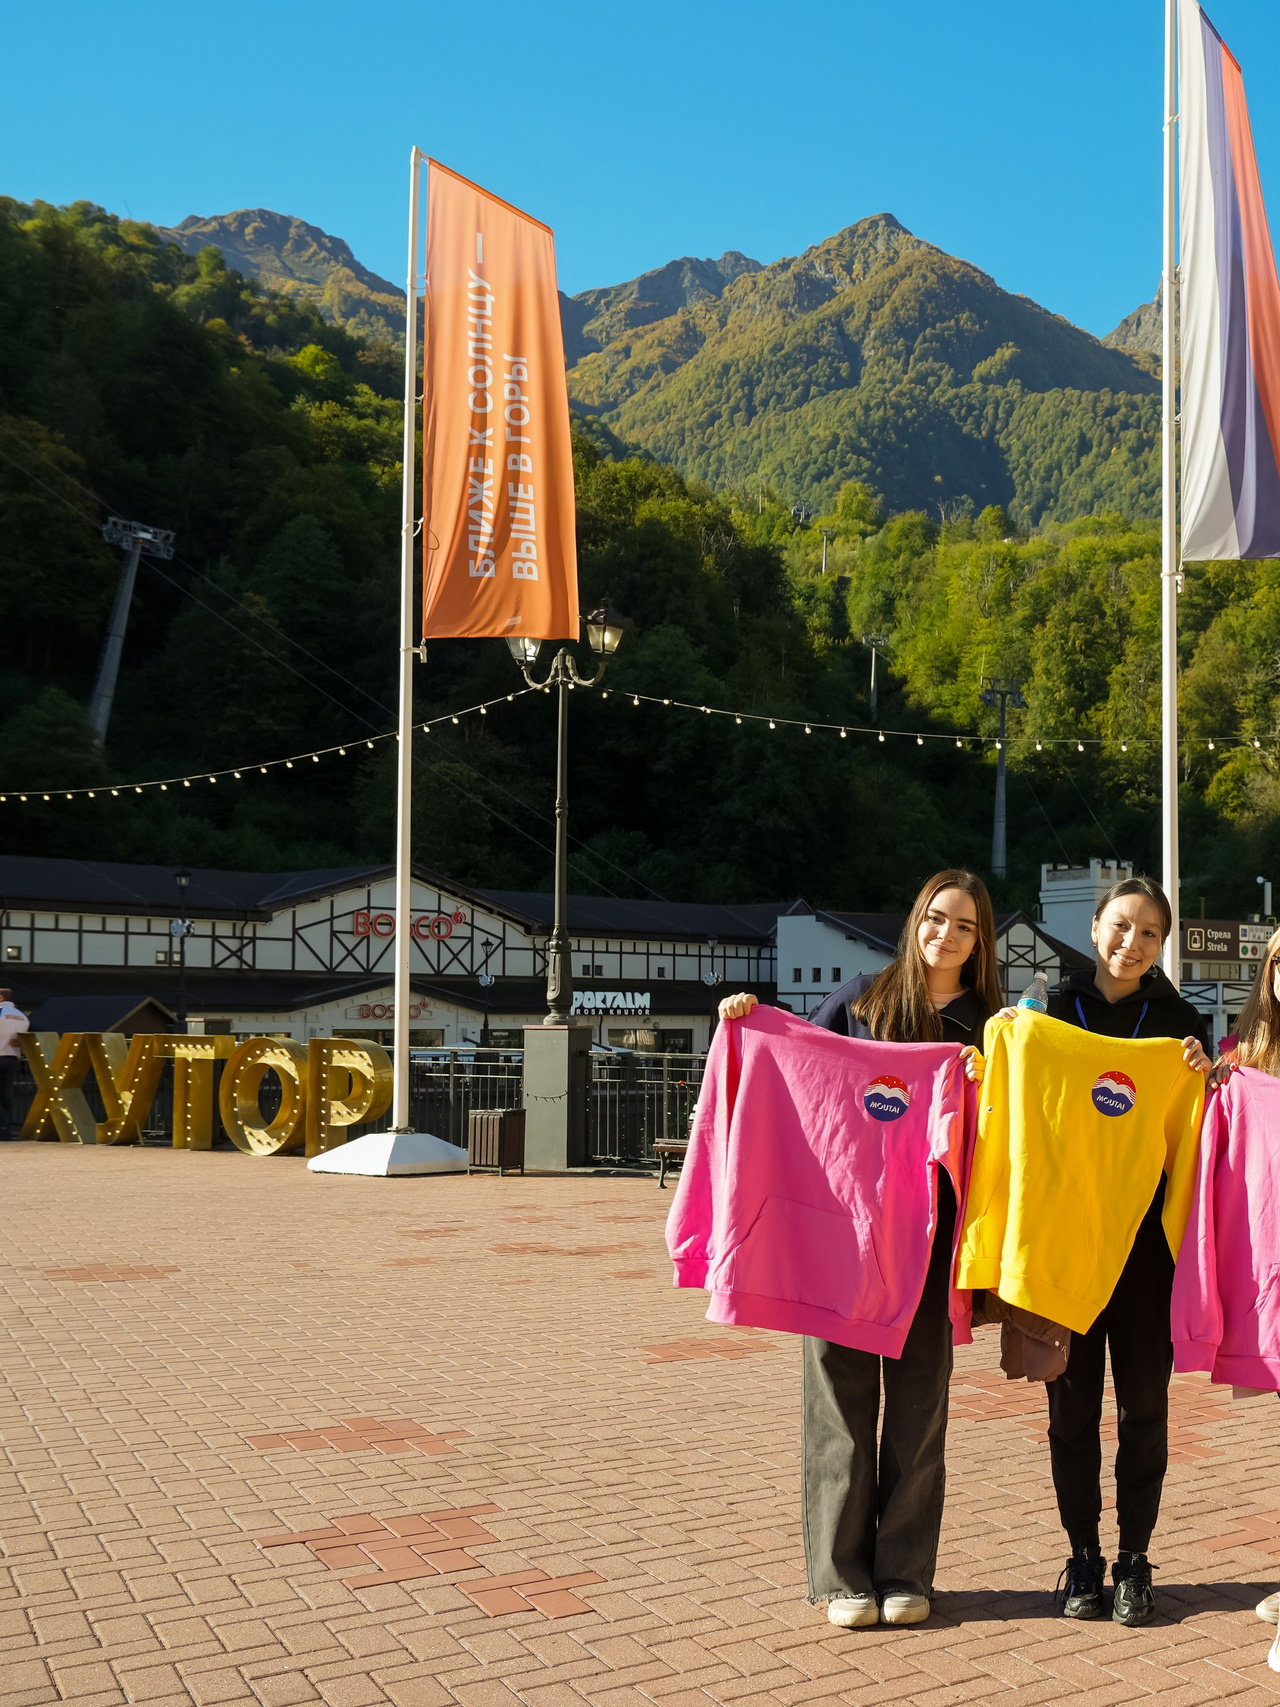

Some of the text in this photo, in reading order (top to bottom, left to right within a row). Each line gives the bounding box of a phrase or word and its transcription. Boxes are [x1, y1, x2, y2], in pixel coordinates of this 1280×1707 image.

[467, 267, 495, 414] СОЛНЦУ
[468, 426, 494, 447] К
[503, 353, 539, 581] ВЫШЕ В ГОРЫ
[468, 457, 496, 578] БЛИЖЕ
[354, 911, 453, 940] BOCO
[1207, 929, 1232, 940] Стрела
[1207, 942, 1228, 952] Strela
[361, 1004, 422, 1019] BOSO
[17, 1031, 393, 1157] ХУТОР
[1096, 1094, 1126, 1111] MOUTAI
[869, 1101, 900, 1114] MOUTAI
